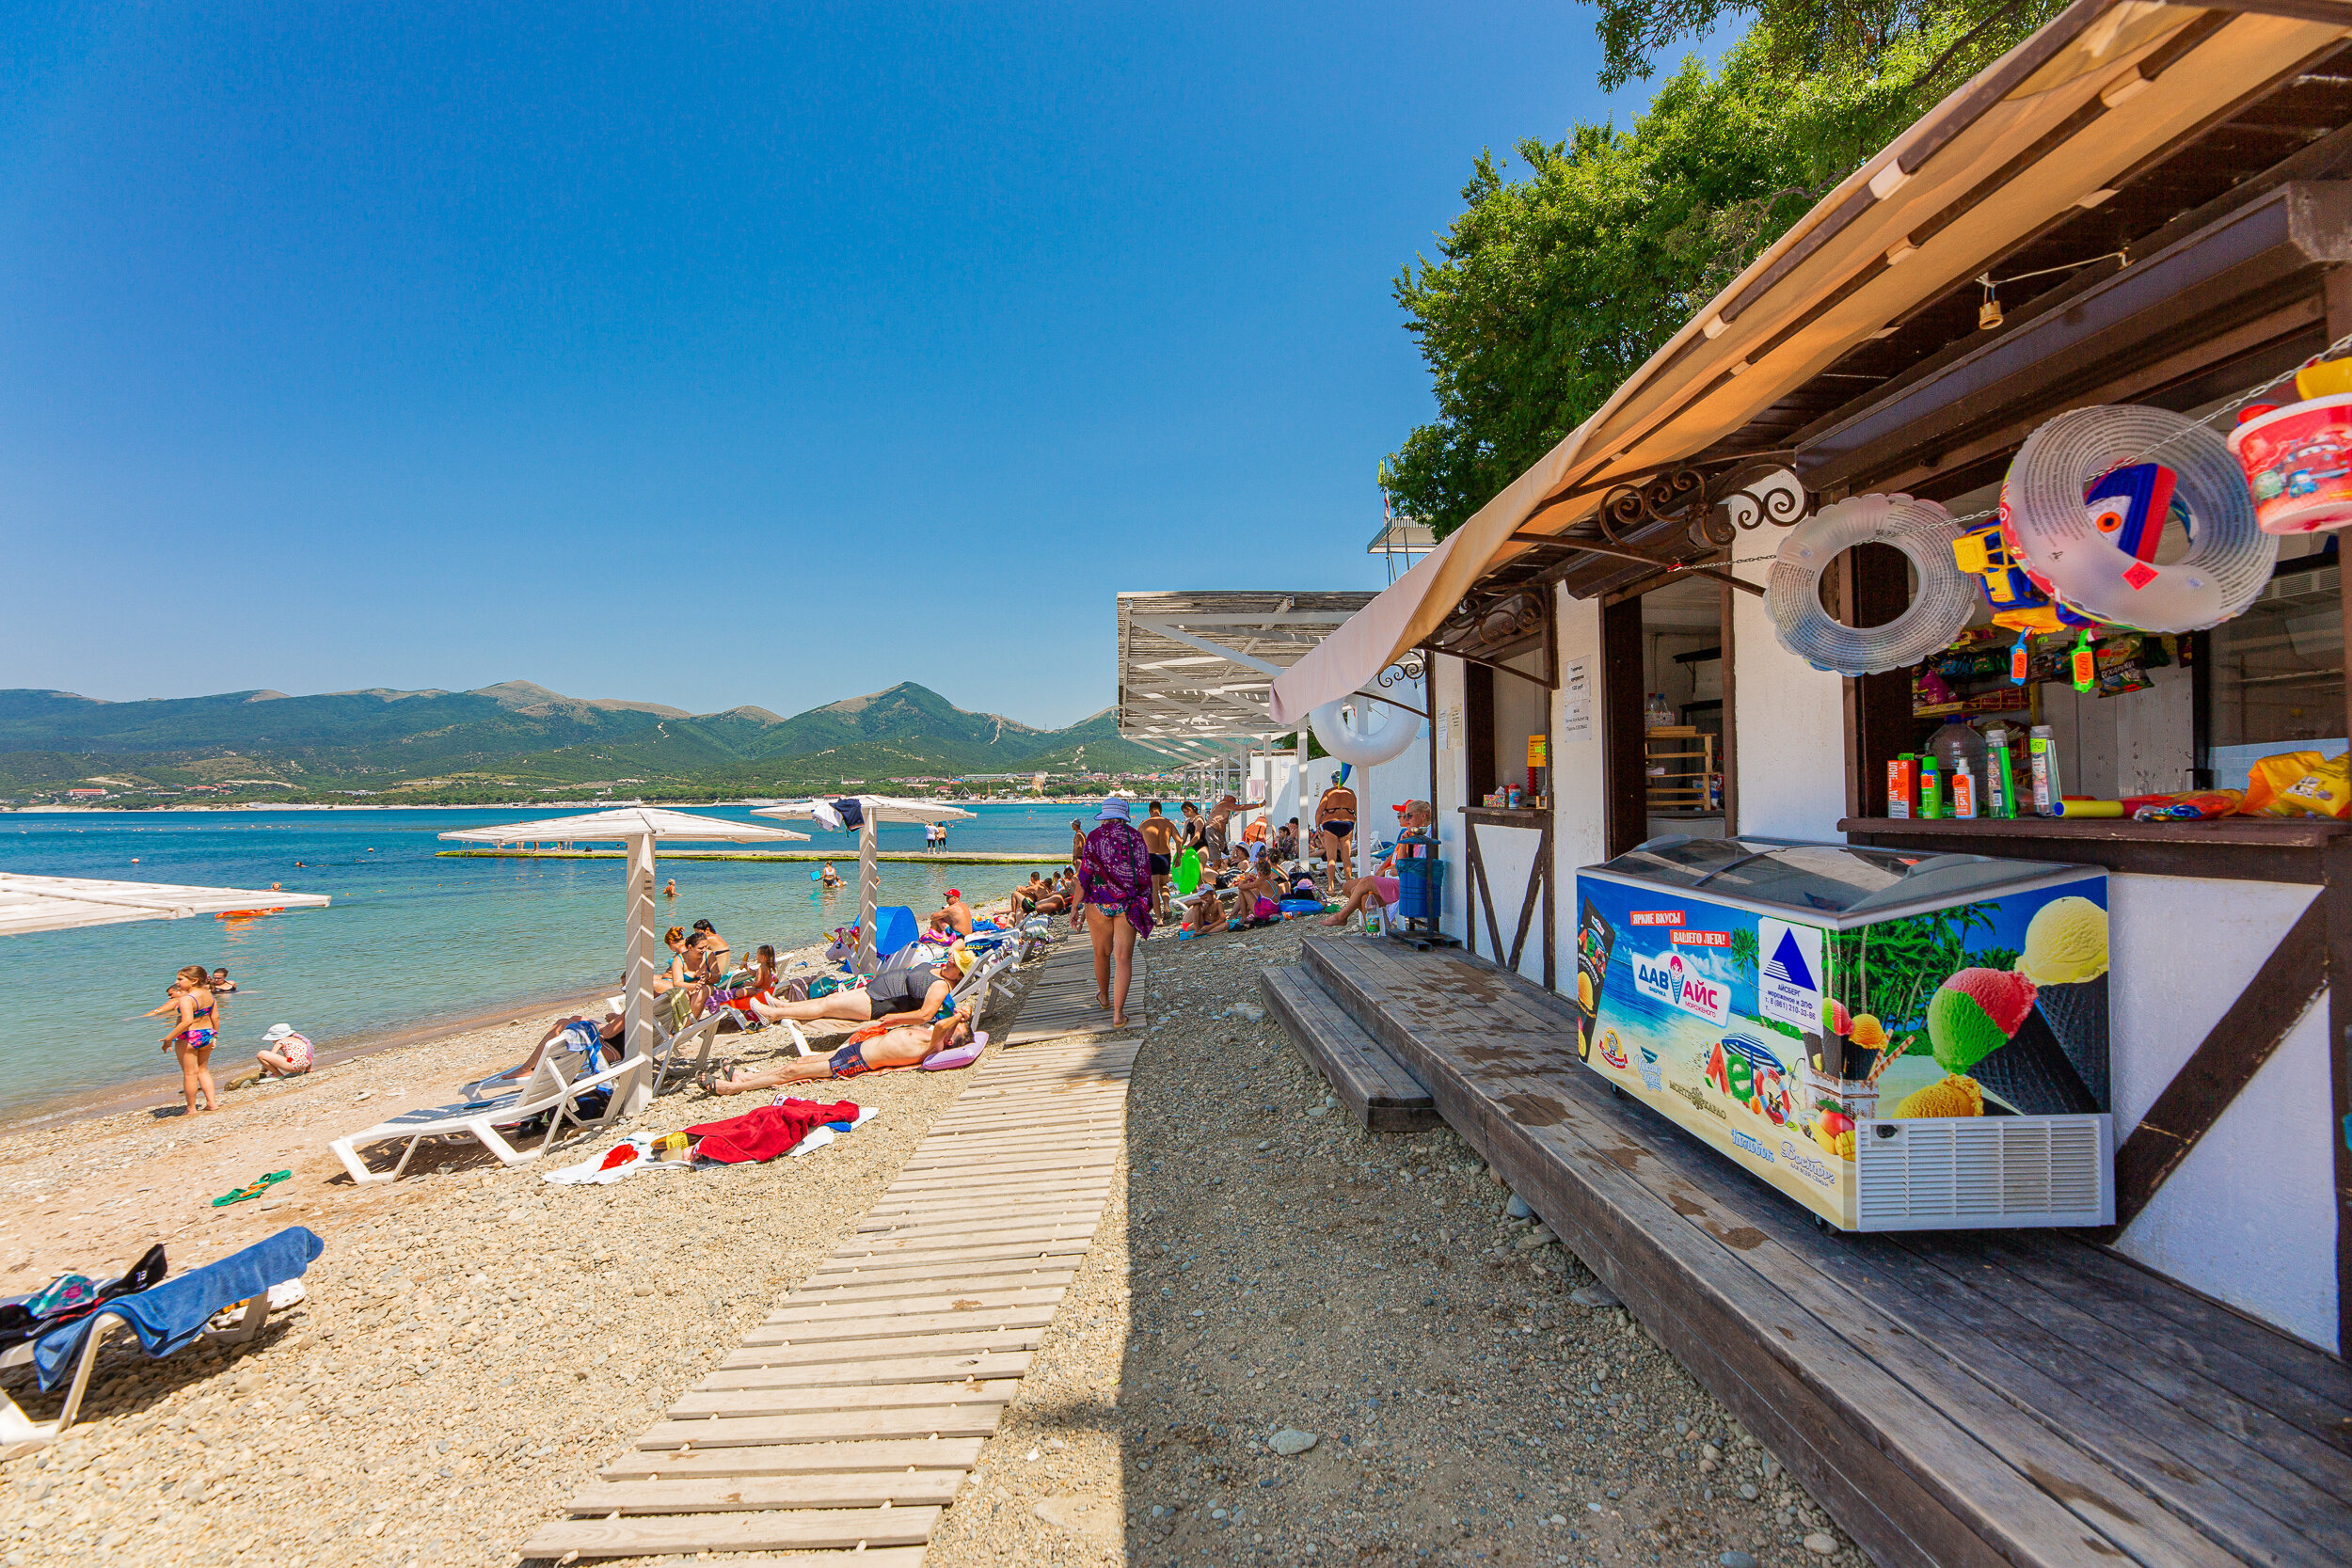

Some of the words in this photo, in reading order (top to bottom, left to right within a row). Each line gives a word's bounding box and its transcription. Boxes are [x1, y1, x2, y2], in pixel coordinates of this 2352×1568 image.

[1888, 762, 1899, 800] ПАНОЛ
[1632, 912, 1654, 924] ЯРКИЕ
[1656, 912, 1681, 924] ВКУСЫ
[1674, 932, 1702, 943] ВАШЕГО
[1704, 933, 1725, 945] ЛЕТА!
[1648, 986, 1666, 997] ФАБРИКА
[1683, 979, 1718, 1010] АЙС
[1778, 984, 1801, 997] АЙСБЕРГ
[1685, 1001, 1717, 1018] МОРОЖЕНОГО
